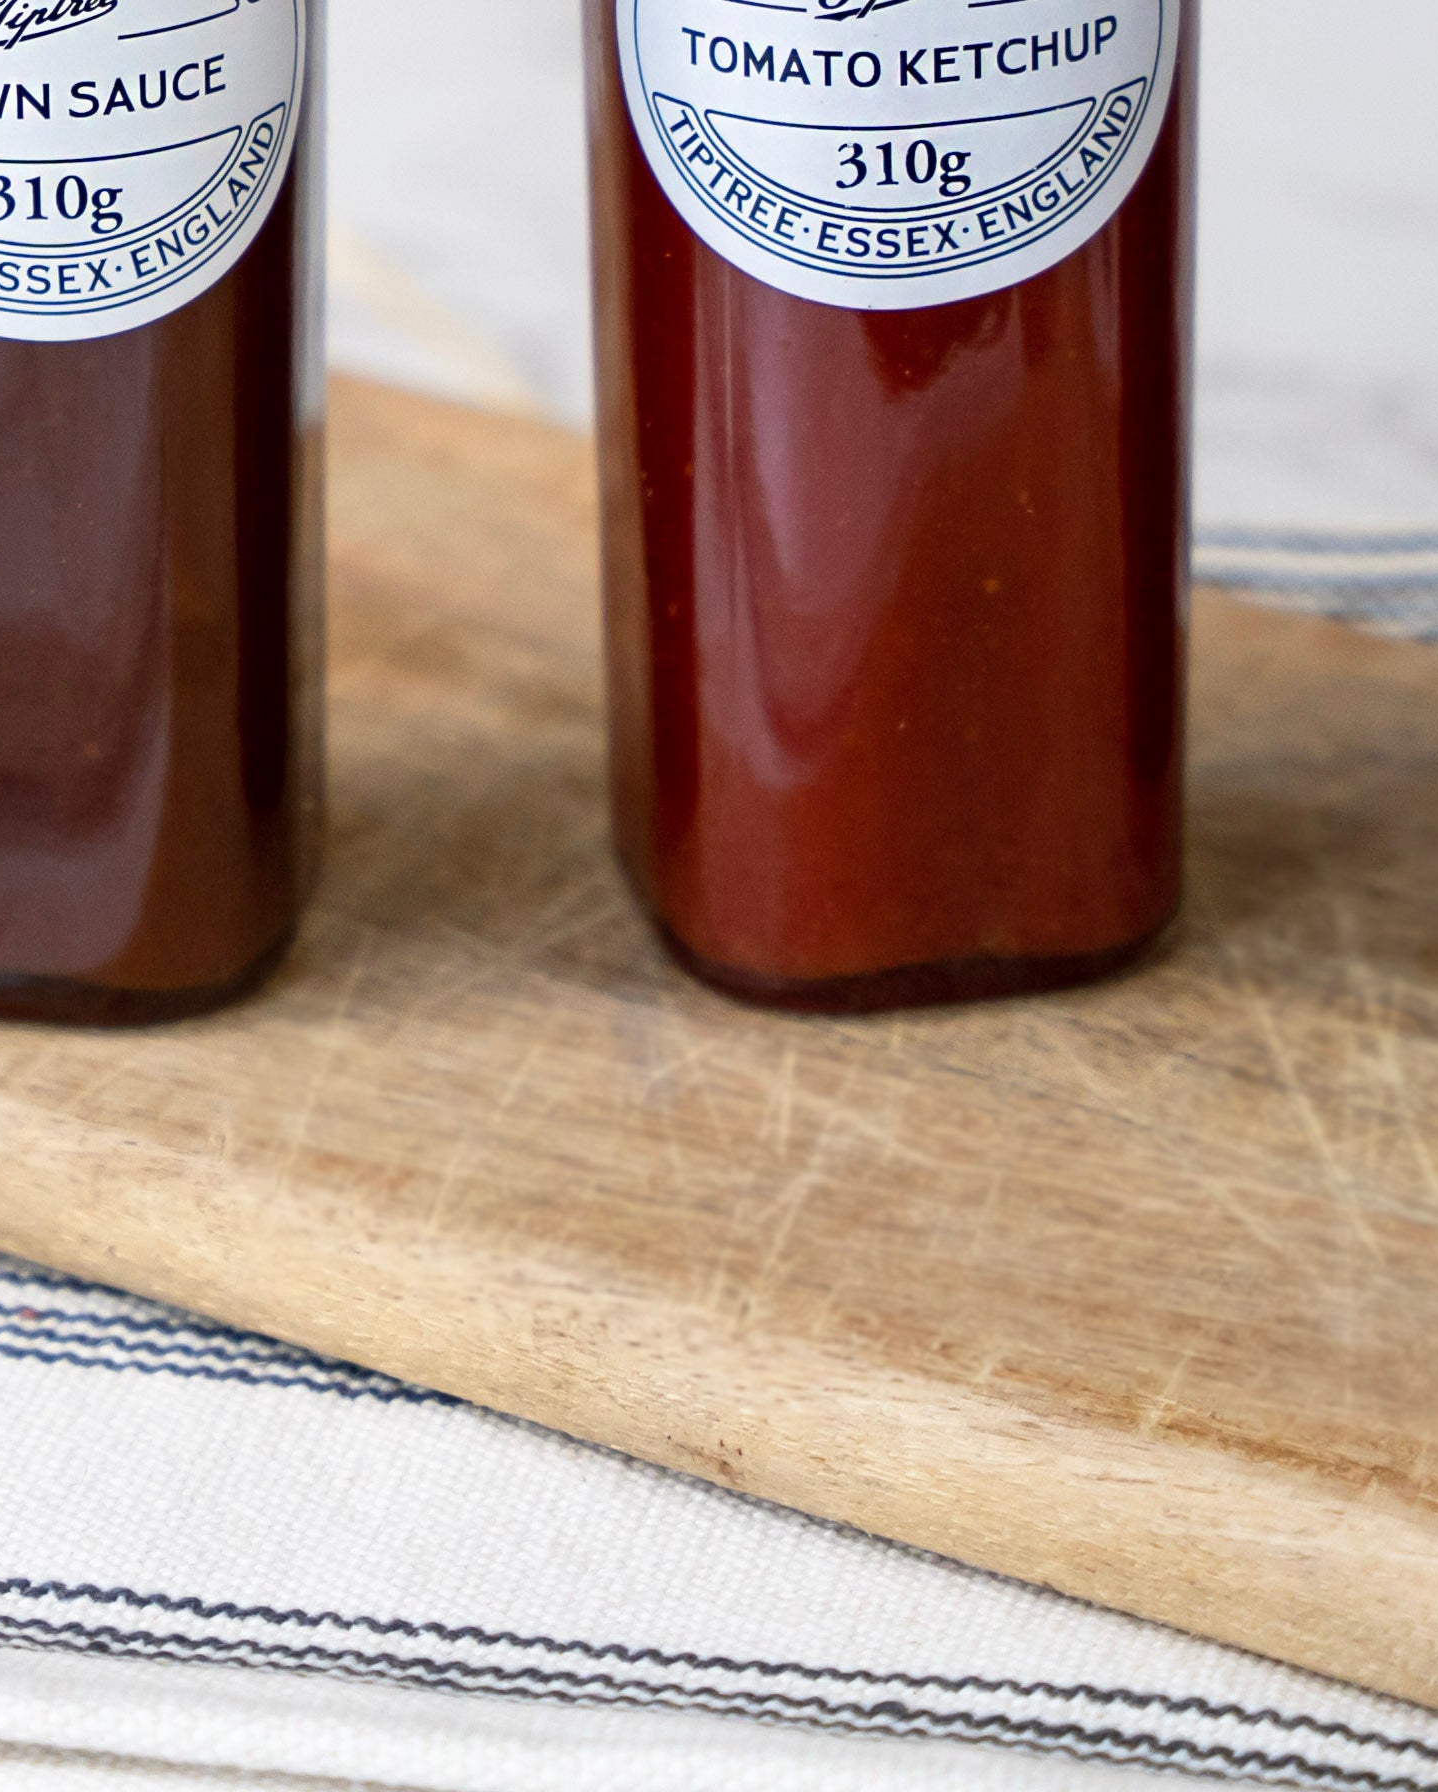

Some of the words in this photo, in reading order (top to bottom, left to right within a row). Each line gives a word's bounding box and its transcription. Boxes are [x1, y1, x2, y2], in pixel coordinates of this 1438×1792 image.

[682, 27, 882, 88] TOMATO
[899, 15, 1118, 87] KETCHUP
[69, 54, 227, 118] SAUCE
[836, 139, 971, 197] 310g
